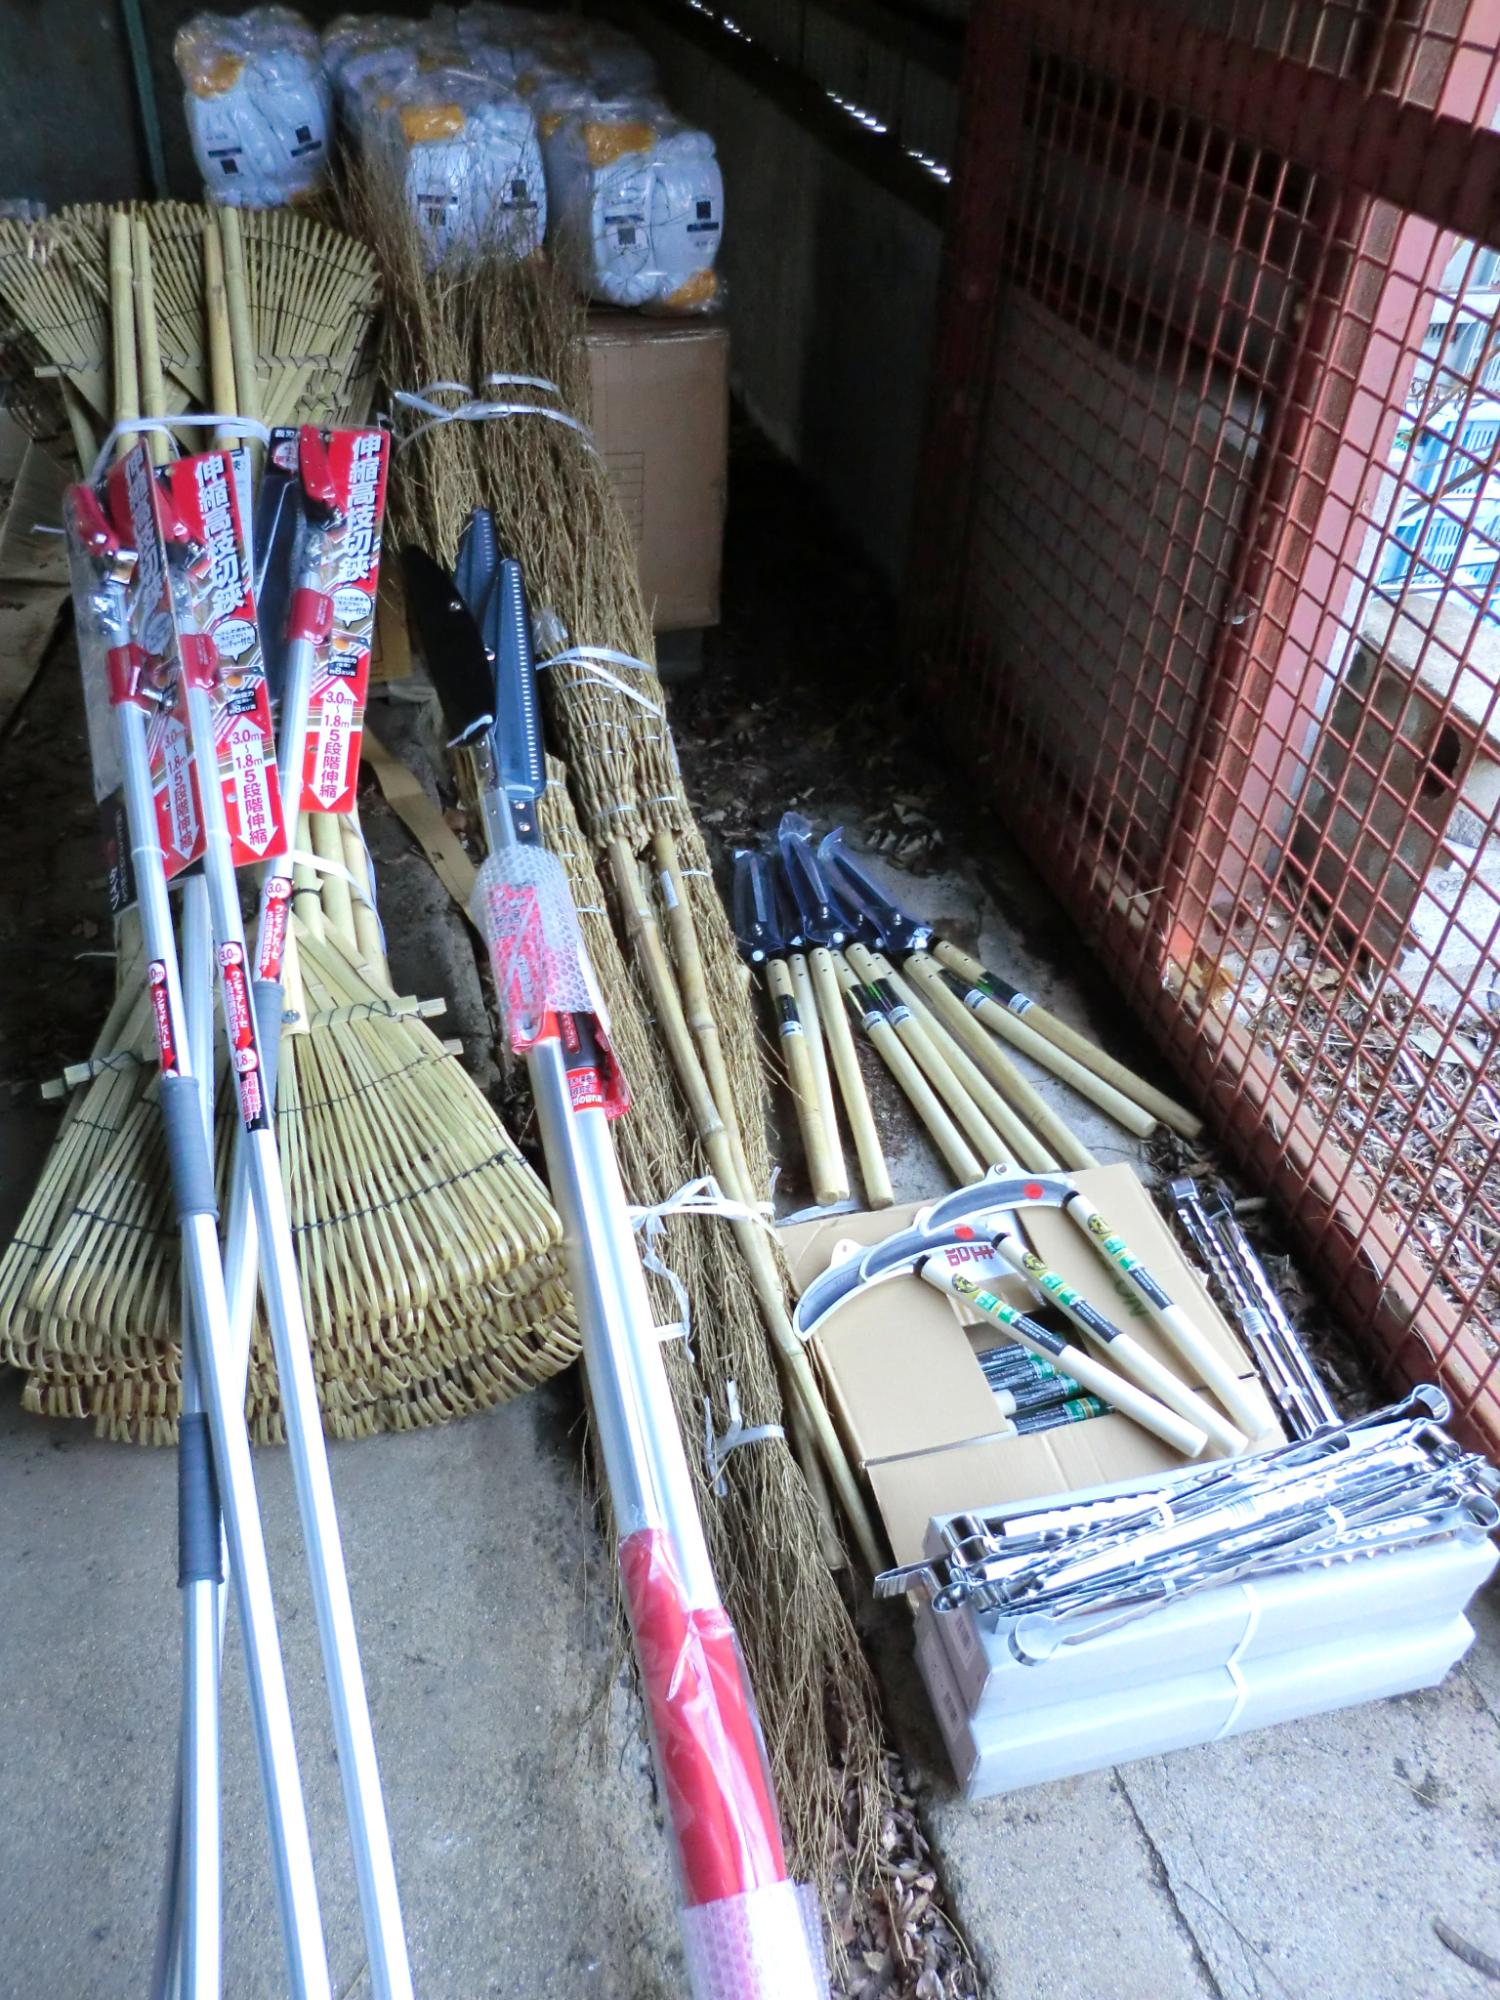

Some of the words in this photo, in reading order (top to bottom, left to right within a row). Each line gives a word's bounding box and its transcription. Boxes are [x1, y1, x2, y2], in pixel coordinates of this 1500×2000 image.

[326, 691, 352, 705] 3.0m
[325, 714, 350, 728] 1.8m
[232, 729, 260, 745] 3.0m
[236, 754, 262, 770] 1.8m
[319, 729, 342, 798] 5段階伸縮
[244, 769, 267, 845] 5段階伸縮
